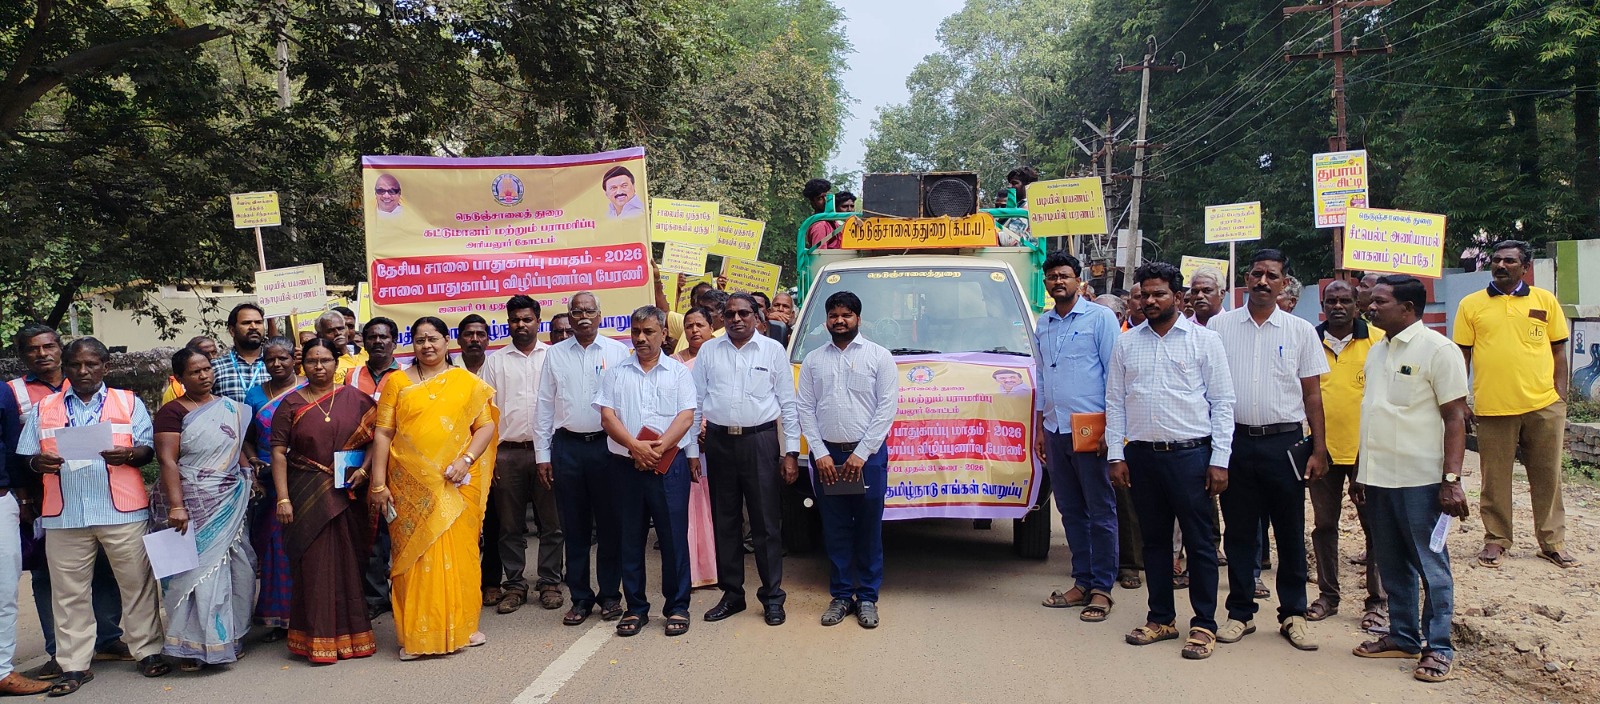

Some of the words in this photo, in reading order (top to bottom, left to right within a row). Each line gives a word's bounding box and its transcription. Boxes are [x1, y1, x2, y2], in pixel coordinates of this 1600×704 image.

[1318, 163, 1362, 182] துபாய்
[1336, 178, 1362, 188] சிட்டி
[1036, 193, 1060, 207] படியில்
[1063, 191, 1089, 204] பயணம்
[455, 209, 533, 222] நெடுஞ்சாலைத்
[535, 208, 563, 219] துறை
[1032, 209, 1066, 223] நொடியில்
[1069, 207, 1095, 220] மரணம்
[1359, 212, 1411, 223] நெடுஞ்சாலைத்
[1413, 217, 1432, 226] துறை
[423, 226, 491, 238] கட்டுமானம்
[494, 223, 537, 237] மற்றும்
[540, 218, 595, 232] பராமரிப்பு
[851, 219, 946, 242] நெடுஞ்சாலைத்துறை
[1349, 224, 1387, 242] சீட்பெல்ட்
[1390, 229, 1440, 247] அணியாமல்
[466, 239, 512, 249] அரியலூர்
[515, 235, 556, 247] கோட்டம்
[376, 261, 420, 279] தேசிய
[424, 261, 469, 275] சாலை
[473, 255, 544, 273] பாதுகாப்பு
[548, 250, 592, 268] மாதம்
[605, 248, 642, 262] 2026
[1353, 248, 1390, 263] வாகனம்
[1392, 252, 1428, 268] ஓட்டாதே
[378, 285, 424, 298] சாலை
[427, 275, 499, 297] பாதுகாப்பு
[502, 269, 592, 292] விழிப்புணர்வு
[595, 265, 643, 283] பேரணி
[867, 270, 961, 278] நெடுஞ்சாலைத்துறை
[264, 279, 286, 292] படியில்
[288, 276, 313, 288] பயணம்
[260, 292, 291, 305] நொடியில்
[292, 288, 318, 300] மரணம்
[438, 302, 473, 314] ஜனவரி
[475, 303, 486, 311] 01
[908, 394, 943, 404] மற்றும்
[946, 393, 992, 404] பராமரிப்பு
[925, 405, 960, 414] கோட்டம்
[894, 422, 949, 440] பாதுகாப்பு
[951, 422, 984, 437] மாதம்
[994, 425, 1022, 438] 2026
[917, 438, 984, 457] விழிப்புணர்வு
[986, 442, 1023, 456] பேரணி
[905, 464, 926, 474] முதல்
[886, 480, 939, 500] தமிழ்நாடு
[941, 479, 979, 495] எங்கள்
